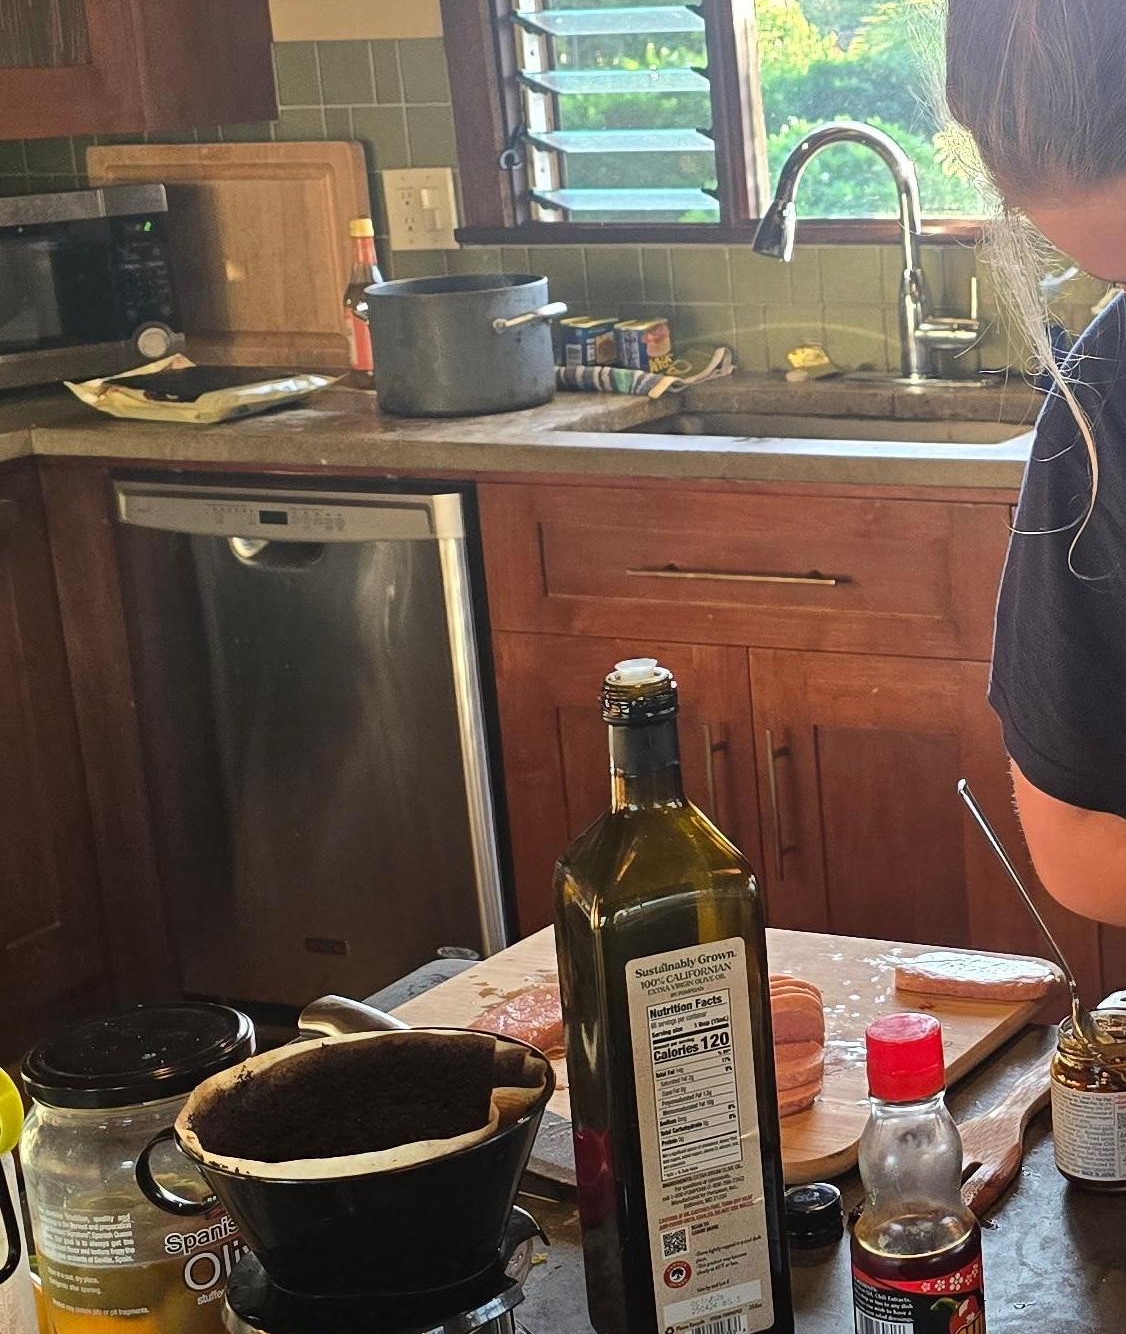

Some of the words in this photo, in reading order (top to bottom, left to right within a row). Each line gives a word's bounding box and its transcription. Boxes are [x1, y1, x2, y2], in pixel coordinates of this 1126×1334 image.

[635, 957, 696, 978] Sustainably
[641, 977, 665, 990] 100%
[666, 962, 732, 984] CALIFORNIAN
[650, 1001, 693, 1019] Nutrition
[695, 995, 722, 1008] Facts
[654, 1043, 699, 1061] Calories
[700, 1032, 730, 1050] 120
[165, 1216, 238, 1256] Spanis
[184, 1240, 249, 1291] Oli
[198, 1289, 226, 1305] stuffe
